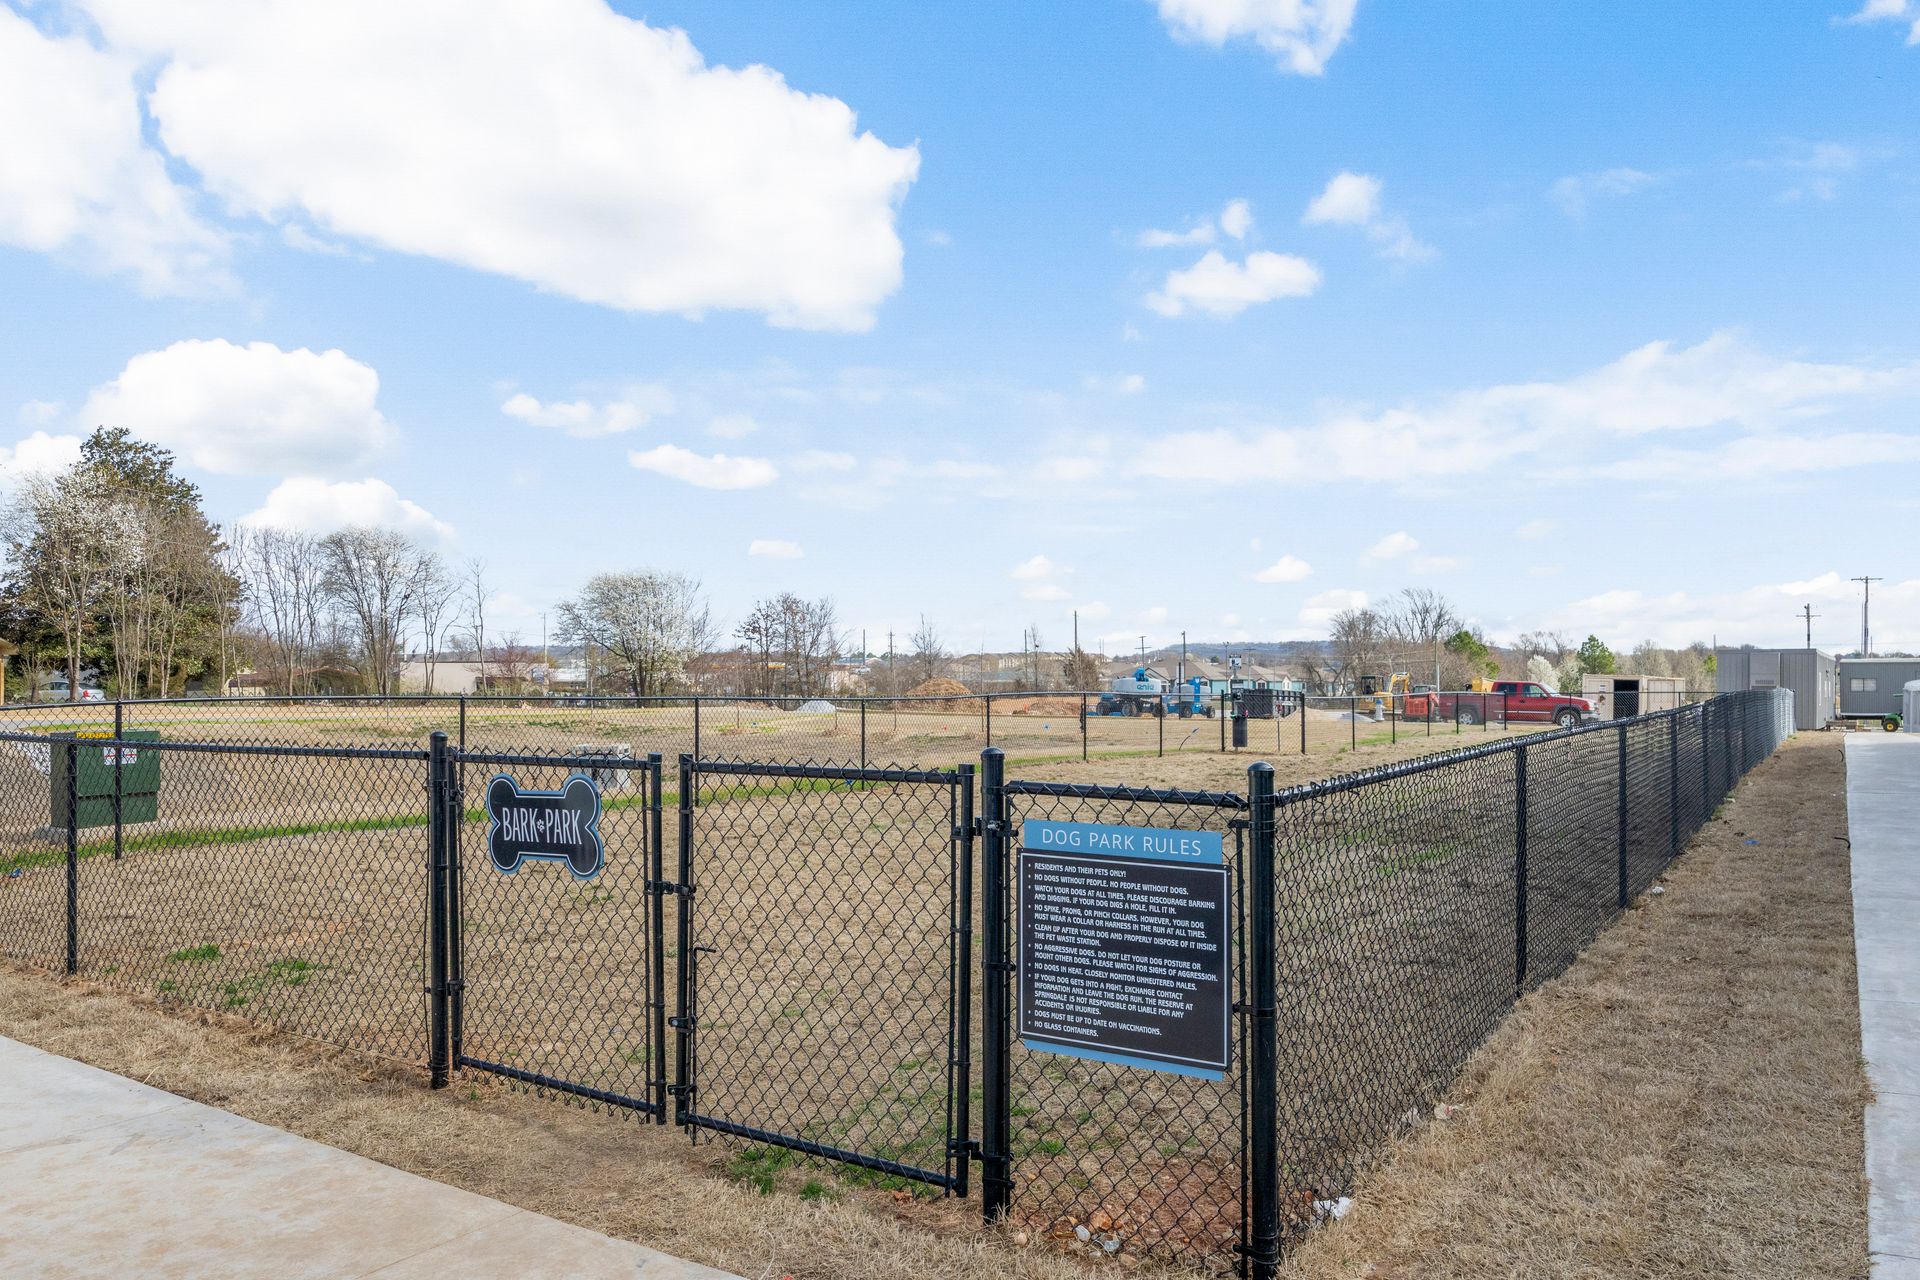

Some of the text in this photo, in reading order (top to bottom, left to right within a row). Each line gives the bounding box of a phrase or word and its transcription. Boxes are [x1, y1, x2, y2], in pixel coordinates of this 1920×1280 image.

[502, 807, 582, 845] BARK PARK
[1042, 828, 1201, 856] DOG PARK RULES
[1035, 863, 1063, 872] RESIDENTS
[1065, 865, 1076, 873] AND
[1078, 866, 1093, 875] THEIR
[1095, 868, 1108, 876] PETS
[1044, 874, 1059, 882] DOGS
[1060, 876, 1085, 885] WITHOUT
[1120, 882, 1141, 890] PEOPLE
[1142, 884, 1168, 893] WITHOUT
[1034, 884, 1053, 893] WATCH
[1054, 886, 1069, 894] YOUR
[1070, 888, 1086, 896] DOGS
[1127, 894, 1148, 902] PLEASE
[1149, 896, 1187, 906] DISCOURAGE
[1188, 900, 1215, 909] BARKING
[1034, 893, 1046, 901] AND
[1079, 898, 1095, 906] YOUR
[1096, 899, 1108, 907] DOG
[1109, 901, 1123, 909] DIGS
[1149, 905, 1160, 913] FILL
[1034, 913, 1049, 921] MUST
[1050, 914, 1066, 923] WEAR
[1072, 917, 1094, 926] COLLAR
[1095, 919, 1104, 927] OR
[1105, 920, 1131, 930] HARNESS
[1132, 923, 1139, 931] IN
[1140, 924, 1151, 932] THE
[1152, 926, 1165, 934] RUN
[1166, 927, 1174, 935] AT
[1175, 928, 1186, 936] ALL
[1084, 909, 1092, 917] OR
[1094, 910, 1110, 919] PINCH
[1172, 919, 1189, 927] YOUR
[1191, 921, 1204, 929] DOG
[1034, 923, 1052, 932] CLEAN
[1053, 925, 1060, 933] UP
[1061, 926, 1079, 935] AFTER
[1079, 929, 1095, 937] YOUR
[1110, 932, 1123, 940] AND
[1124, 934, 1152, 944] PROPERLY
[1153, 937, 1179, 947] DISPOSE
[1180, 940, 1188, 948] OF
[1190, 941, 1195, 949] IT
[1196, 942, 1217, 951] INSIDE
[1034, 932, 1044, 940] THE
[1046, 933, 1055, 941] PET
[1057, 935, 1075, 943] WASTE
[1035, 951, 1054, 960] MOUNT
[1054, 954, 1073, 963] OTHER
[1093, 959, 1113, 968] PLEASE
[1114, 962, 1134, 971] WATCH
[1136, 964, 1148, 972] FOR
[1149, 966, 1167, 975] SIGNS
[1168, 968, 1176, 976] OF
[1044, 944, 1078, 955] AGGRESSIVE
[1108, 952, 1119, 960] NOT
[1132, 955, 1148, 963] YOUR
[1149, 957, 1162, 965] DOG
[1164, 959, 1190, 969] POSTURE
[1192, 962, 1201, 970] OR
[1034, 962, 1043, 970] NO
[1044, 964, 1059, 972] DOGS
[1084, 969, 1108, 978] CLOSELY
[1109, 972, 1135, 982] MONITOR
[1136, 976, 1174, 987] UNNEUTERED
[1040, 974, 1056, 982] YOUR
[1057, 976, 1069, 984] DOG
[1070, 978, 1084, 986] GETS
[1085, 980, 1099, 988] INTO
[1124, 985, 1155, 996] EXCHANGE
[1156, 990, 1183, 1000] CONTACT
[1034, 982, 1070, 993] INFORMATION
[1072, 987, 1084, 995] AND
[1085, 989, 1102, 998] LEAVE
[1104, 991, 1114, 999] THE
[1116, 993, 1128, 1001] DOG
[1145, 997, 1156, 1005] THE
[1158, 999, 1184, 1009] RESERVE
[1035, 990, 1184, 1018] SPRINGDALE IS NOT RESPONSIBLE OR LIABLE FOR ANY
[1035, 999, 1064, 1010] ACCIDENTS
[1065, 1003, 1074, 1011] OR
[1034, 1010, 1050, 1018] DOGS
[1051, 1012, 1066, 1021] MUST
[1067, 1014, 1074, 1022] BE
[1084, 1017, 1092, 1025] TO
[1093, 1018, 1107, 1027] DATE
[1108, 1021, 1117, 1029] ON
[1035, 1020, 1043, 1028] NO
[1044, 1022, 1062, 1031] GLASS
